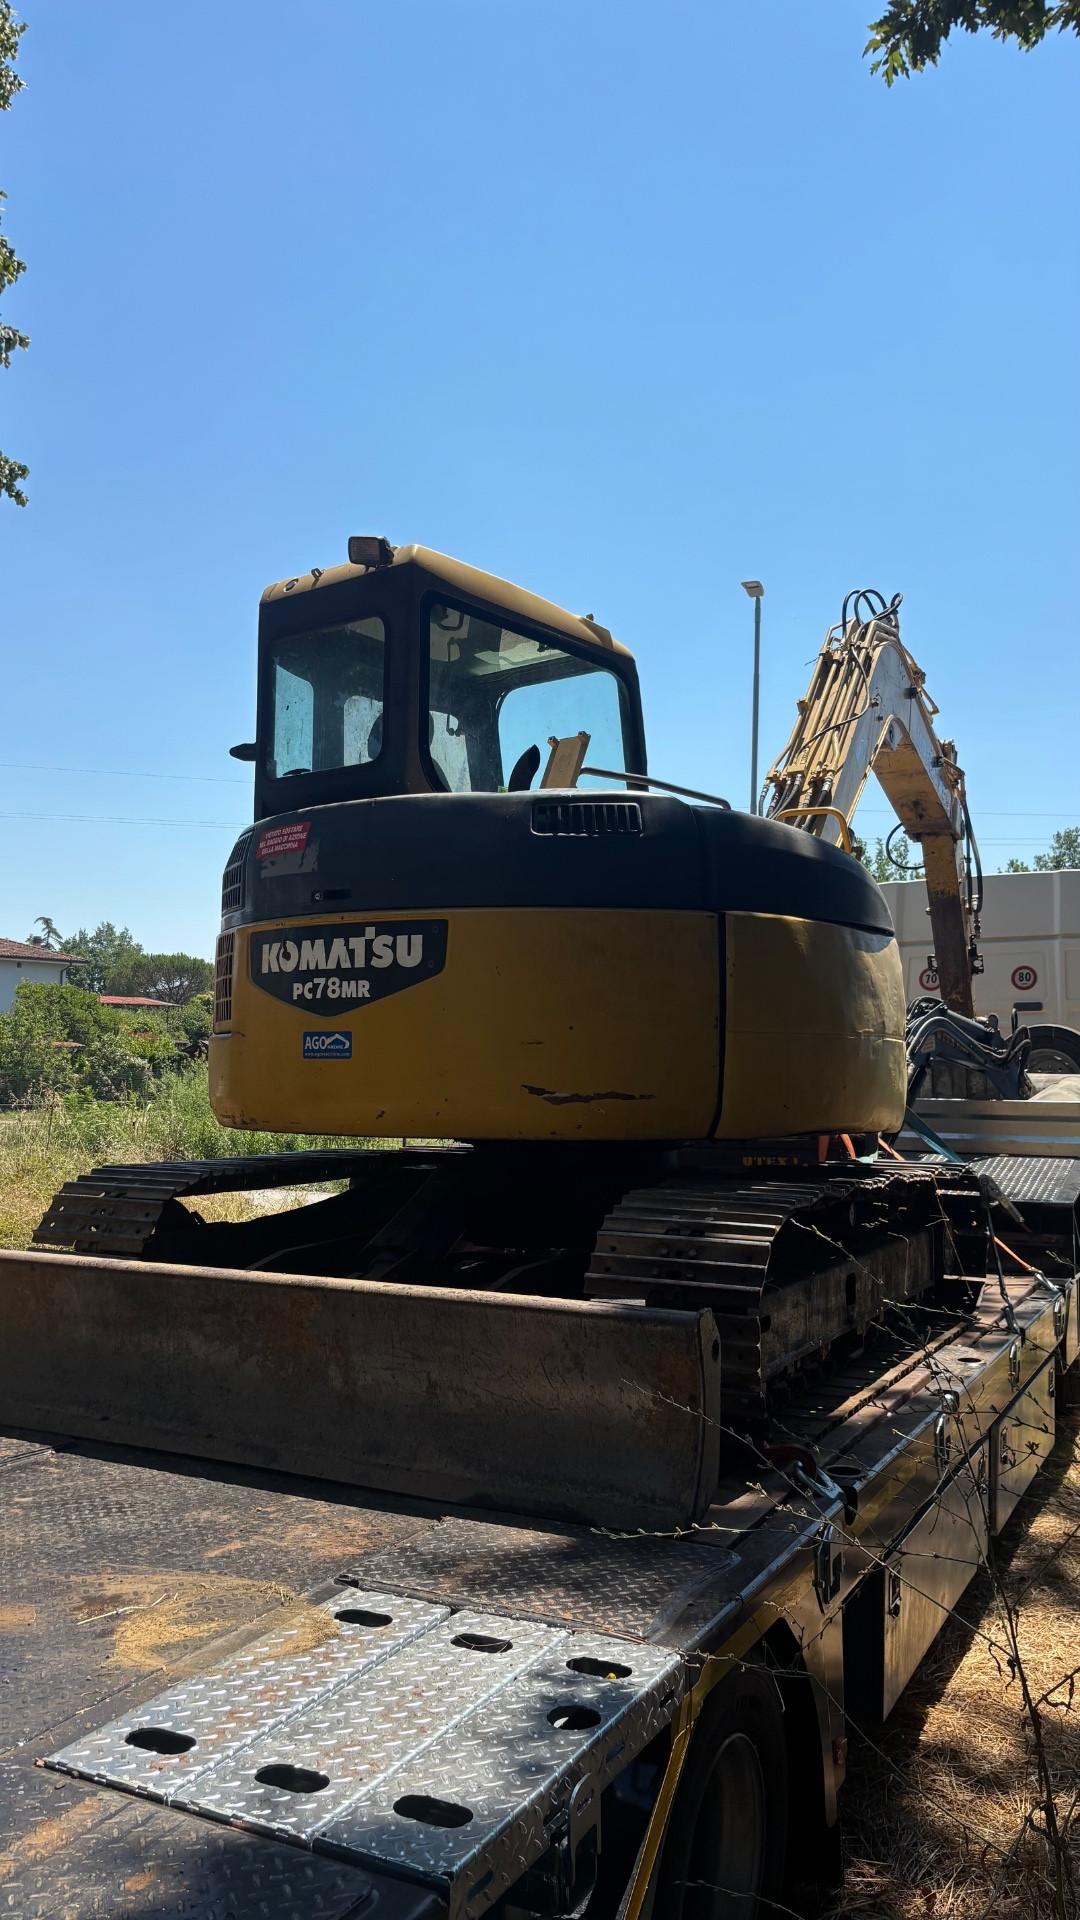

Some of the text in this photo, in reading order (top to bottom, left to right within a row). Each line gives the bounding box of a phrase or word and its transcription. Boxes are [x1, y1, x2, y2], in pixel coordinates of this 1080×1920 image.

[261, 926, 423, 974] KOMATSU
[925, 974, 938, 984] 70
[1018, 972, 1031, 982] 80
[292, 976, 371, 1000] PC78MR
[304, 1035, 328, 1050] AGO
